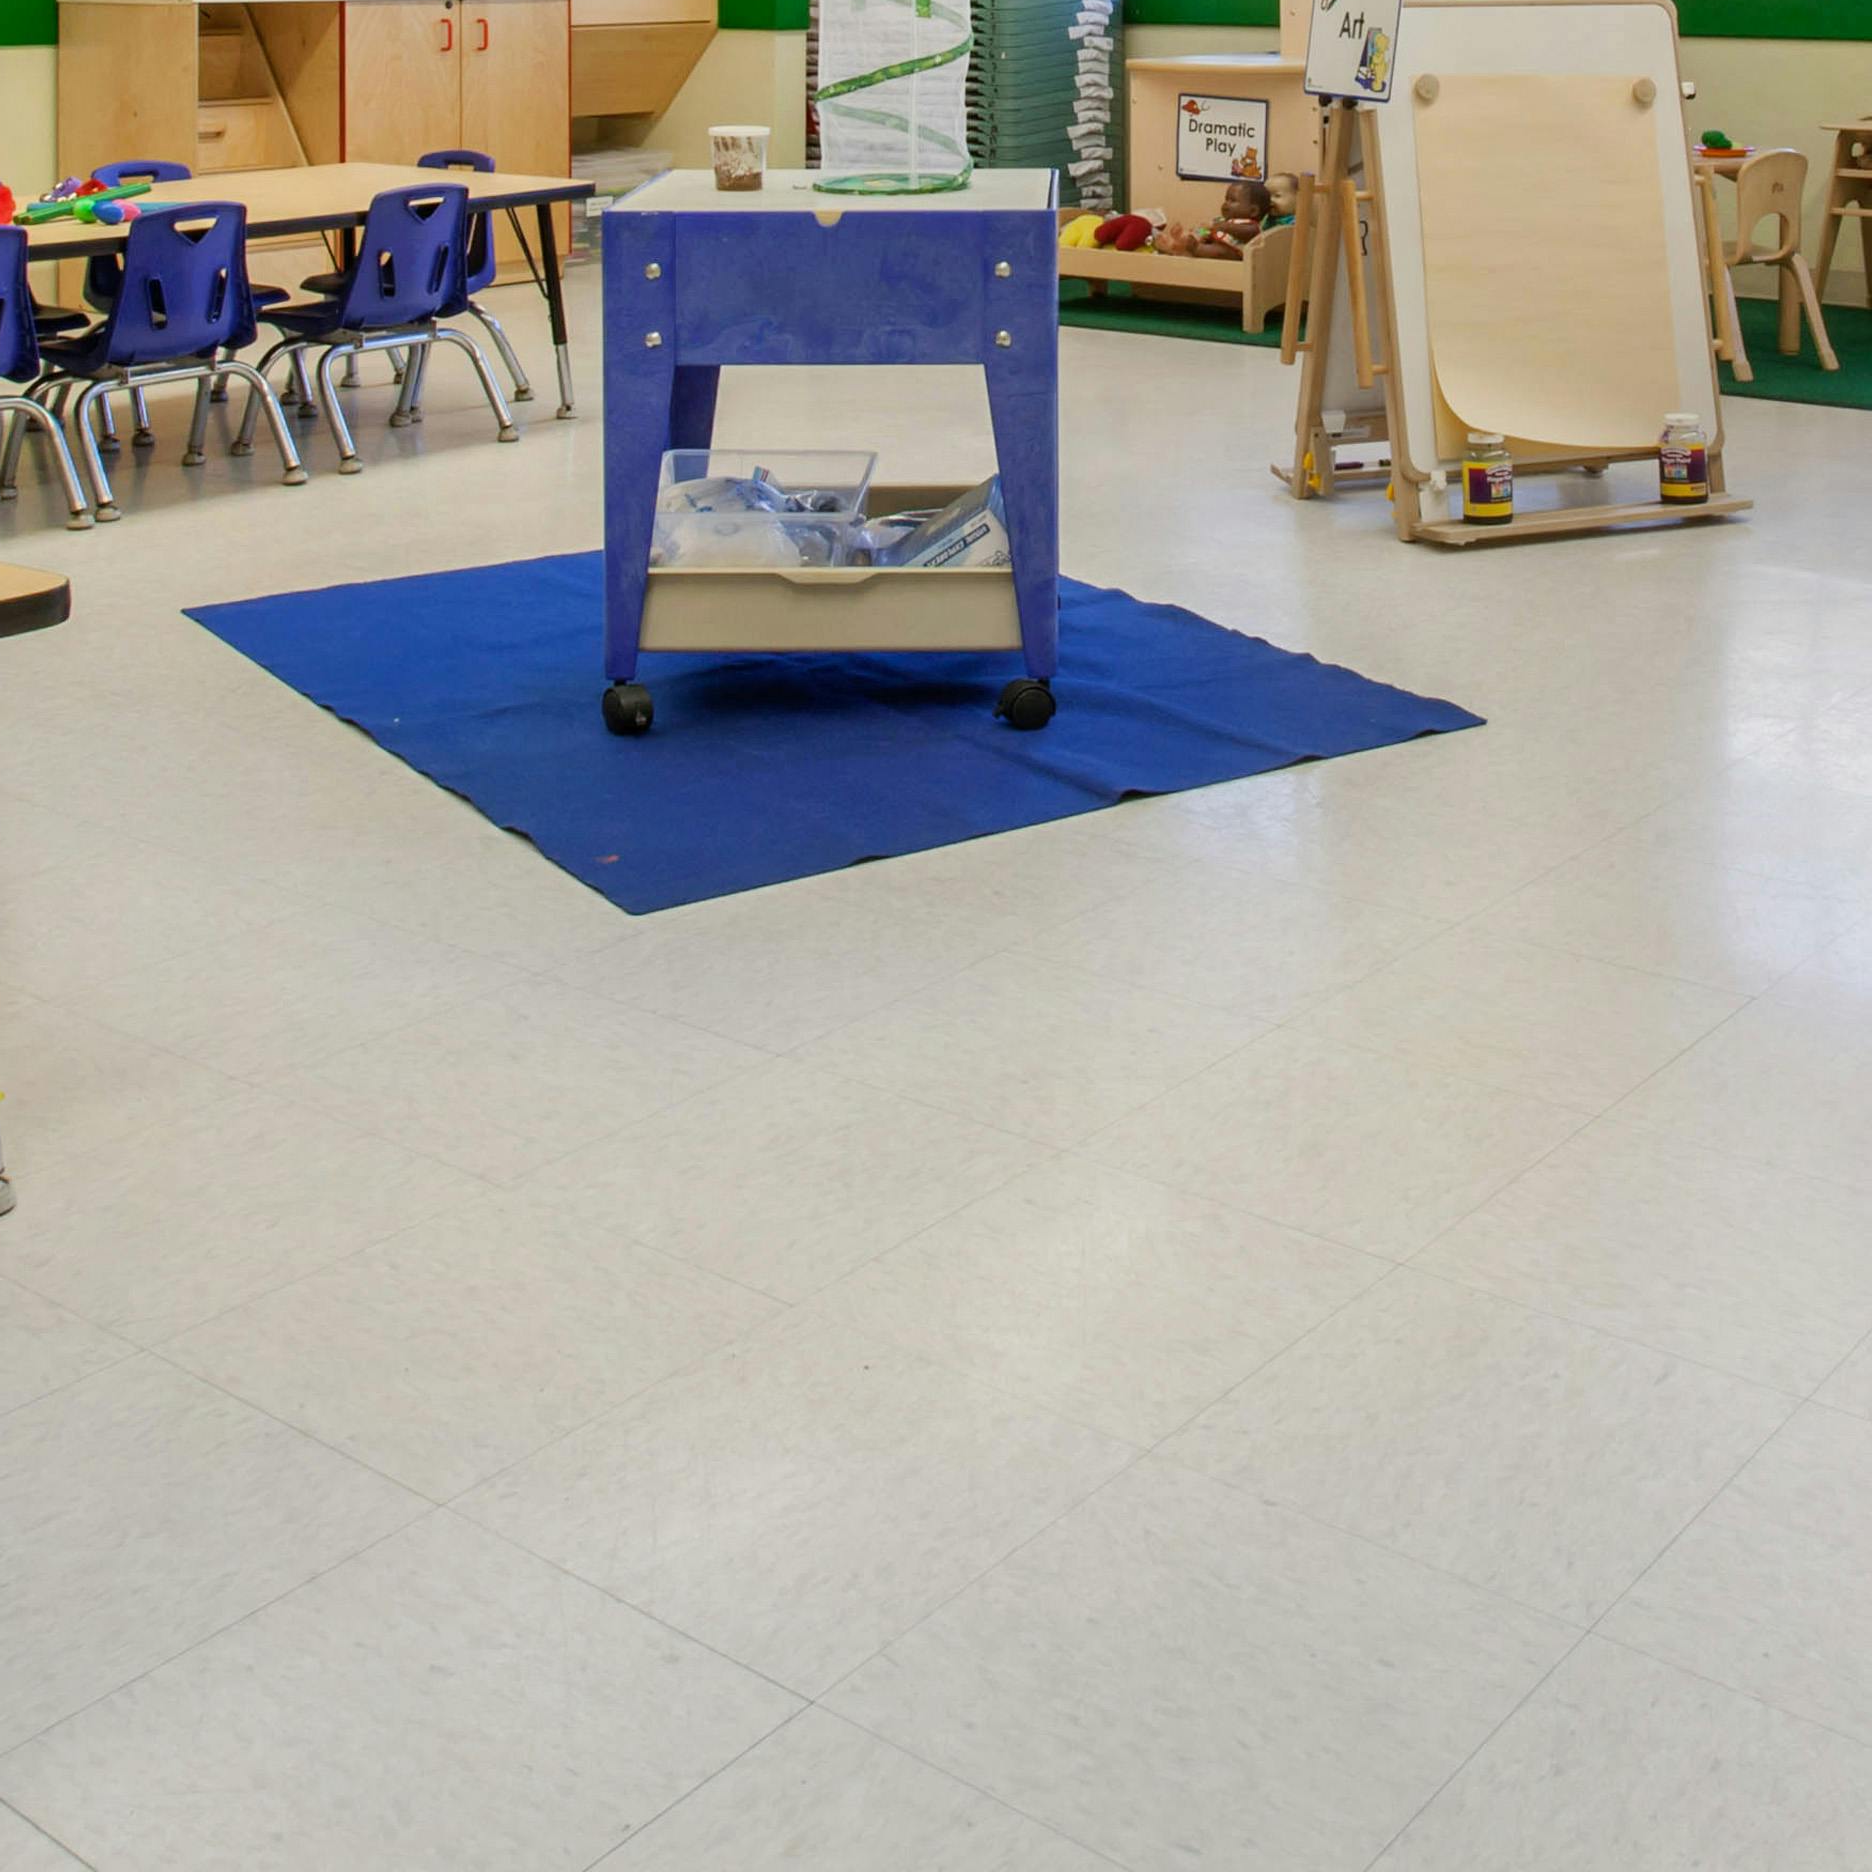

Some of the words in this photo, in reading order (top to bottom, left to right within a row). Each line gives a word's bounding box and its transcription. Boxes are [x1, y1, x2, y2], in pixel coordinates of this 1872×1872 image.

[1338, 11, 1365, 39] Art
[1188, 118, 1256, 138] Dramatic
[1205, 137, 1237, 157] Play
